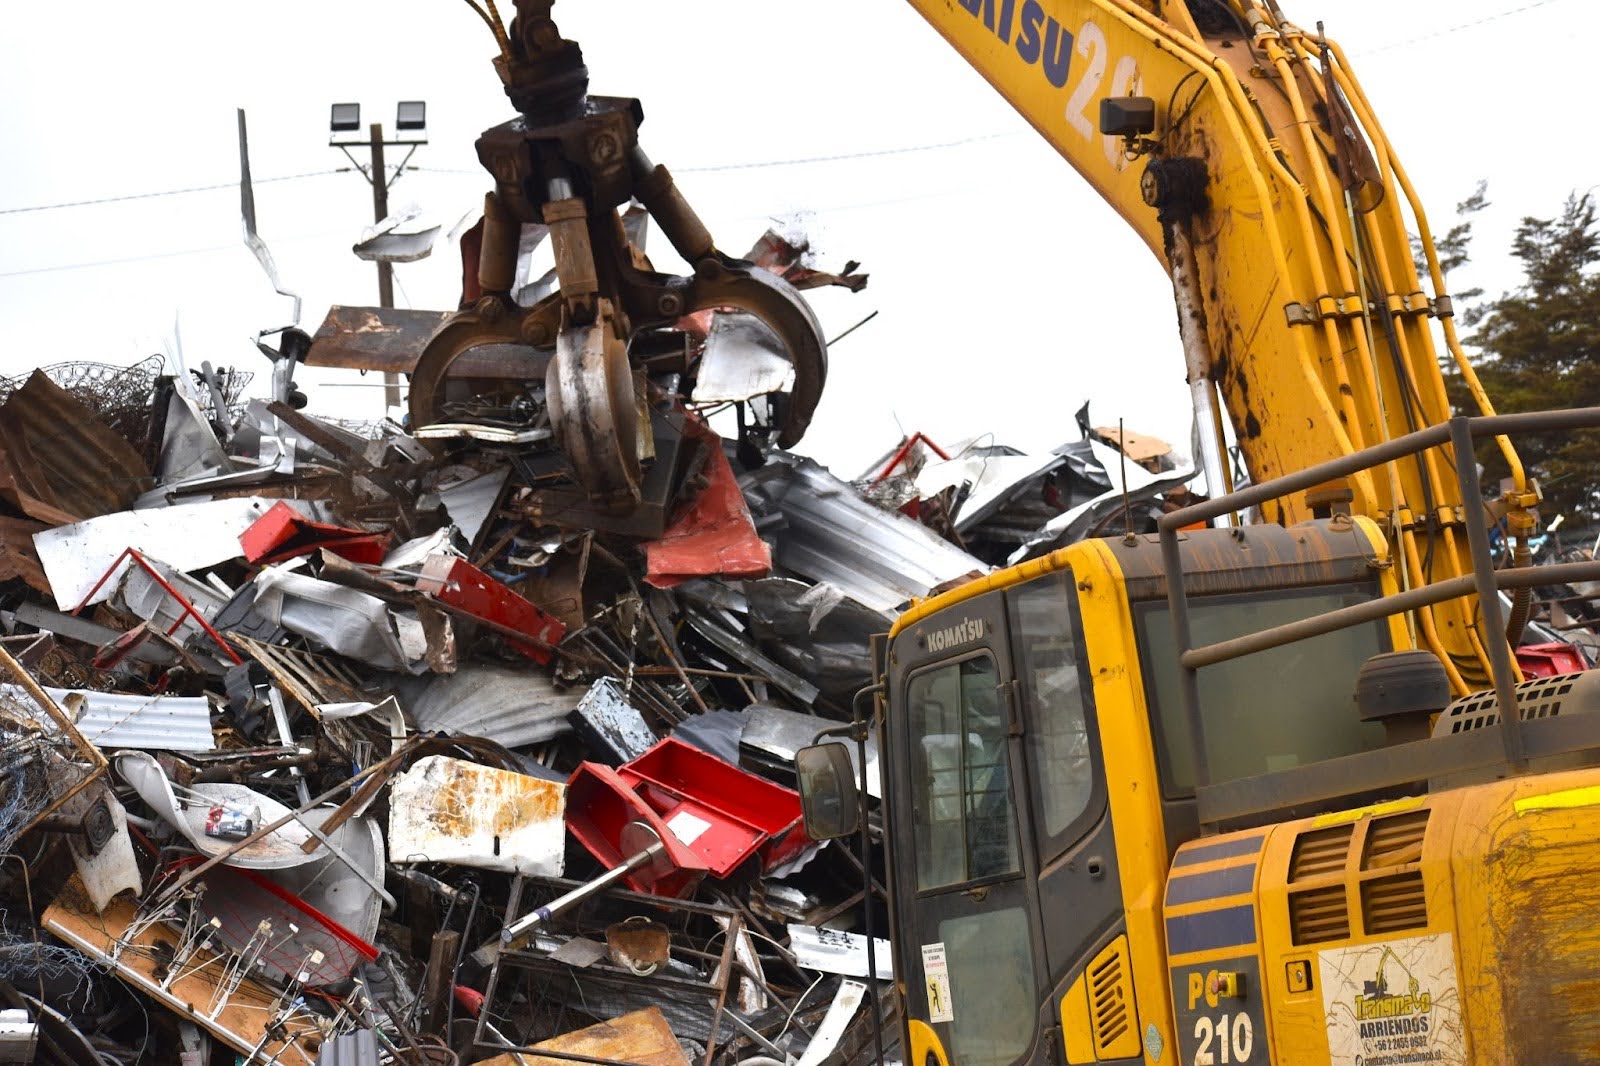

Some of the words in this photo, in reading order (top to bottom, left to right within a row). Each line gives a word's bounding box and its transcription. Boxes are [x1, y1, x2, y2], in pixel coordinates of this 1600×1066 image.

[927, 616, 984, 653] KOMATSU
[1194, 1011, 1253, 1066] 210
[1360, 1016, 1429, 1039] ARRIENDOS
